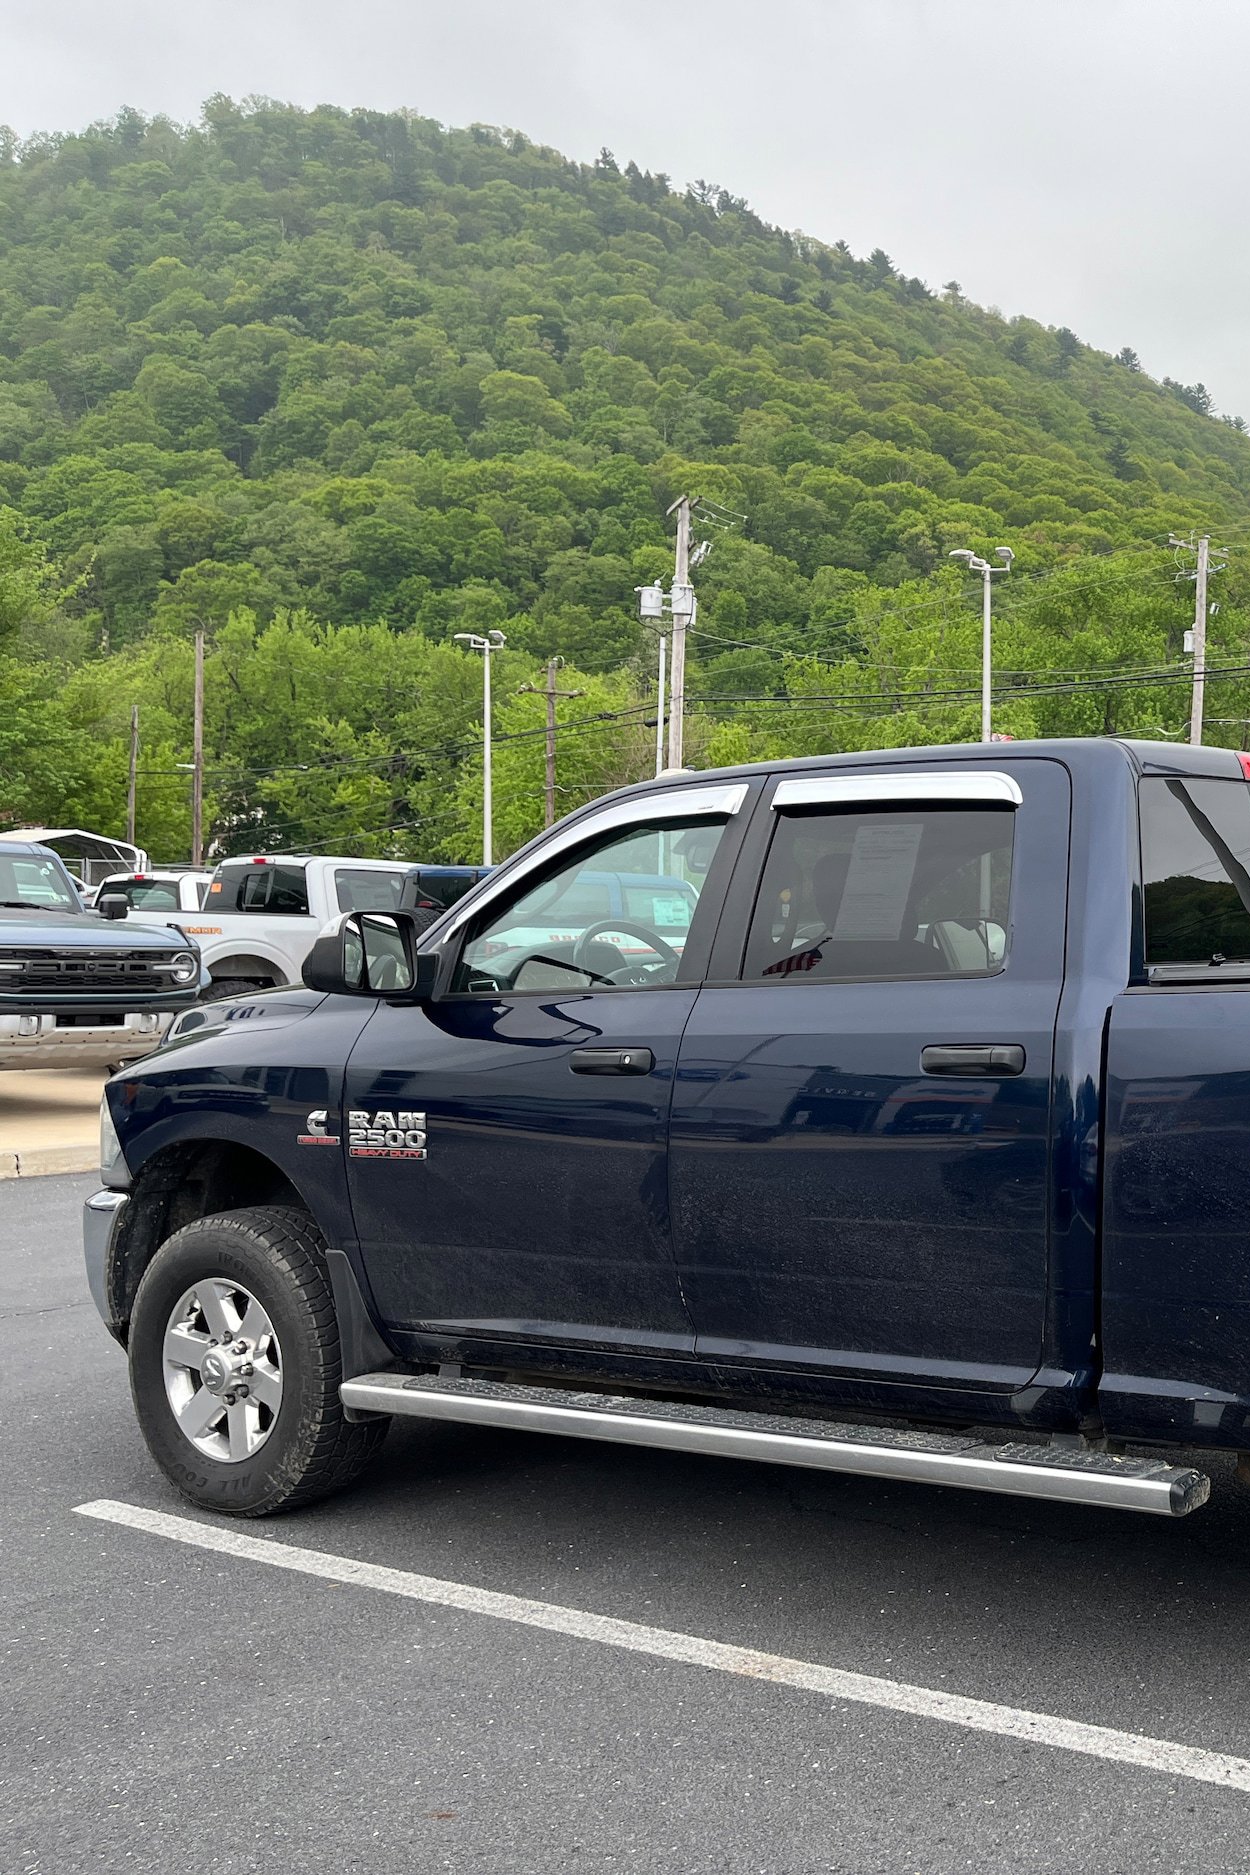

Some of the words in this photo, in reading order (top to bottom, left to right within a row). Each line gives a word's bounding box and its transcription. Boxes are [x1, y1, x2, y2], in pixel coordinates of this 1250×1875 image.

[348, 1111, 427, 1130] RAM
[348, 1128, 427, 1148] 2500
[351, 1148, 389, 1157] HEAVY
[389, 1150, 422, 1158] DUTY
